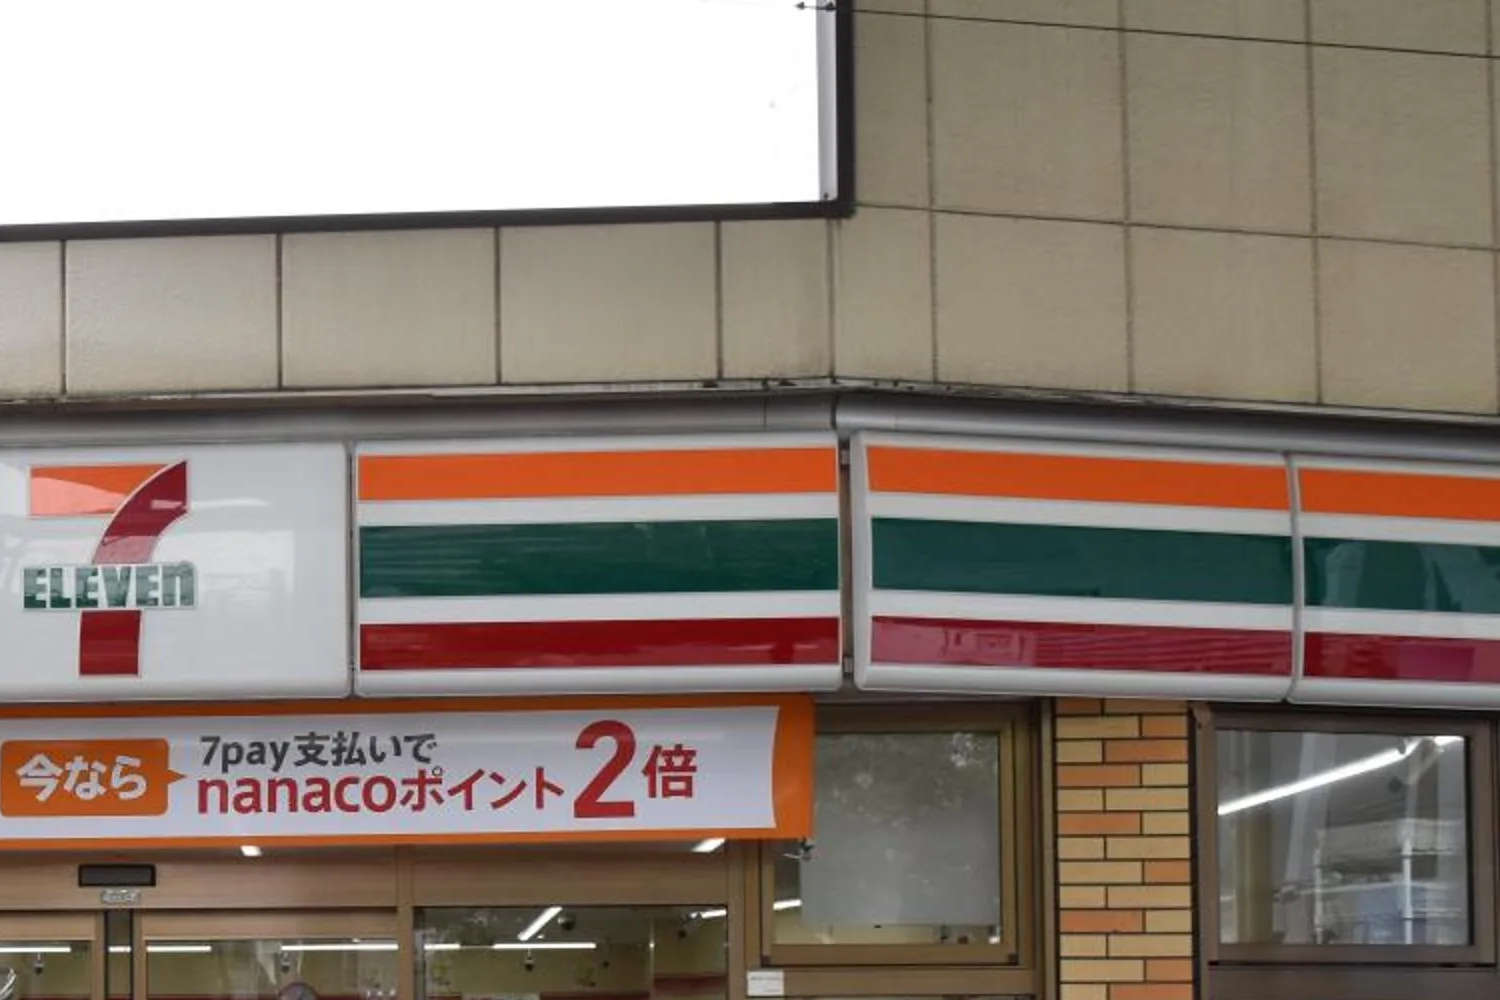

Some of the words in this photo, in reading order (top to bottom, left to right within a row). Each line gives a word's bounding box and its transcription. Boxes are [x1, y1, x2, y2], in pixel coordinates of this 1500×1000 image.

[16, 753, 149, 802] 今なら
[200, 731, 438, 774] 7pay支払いで
